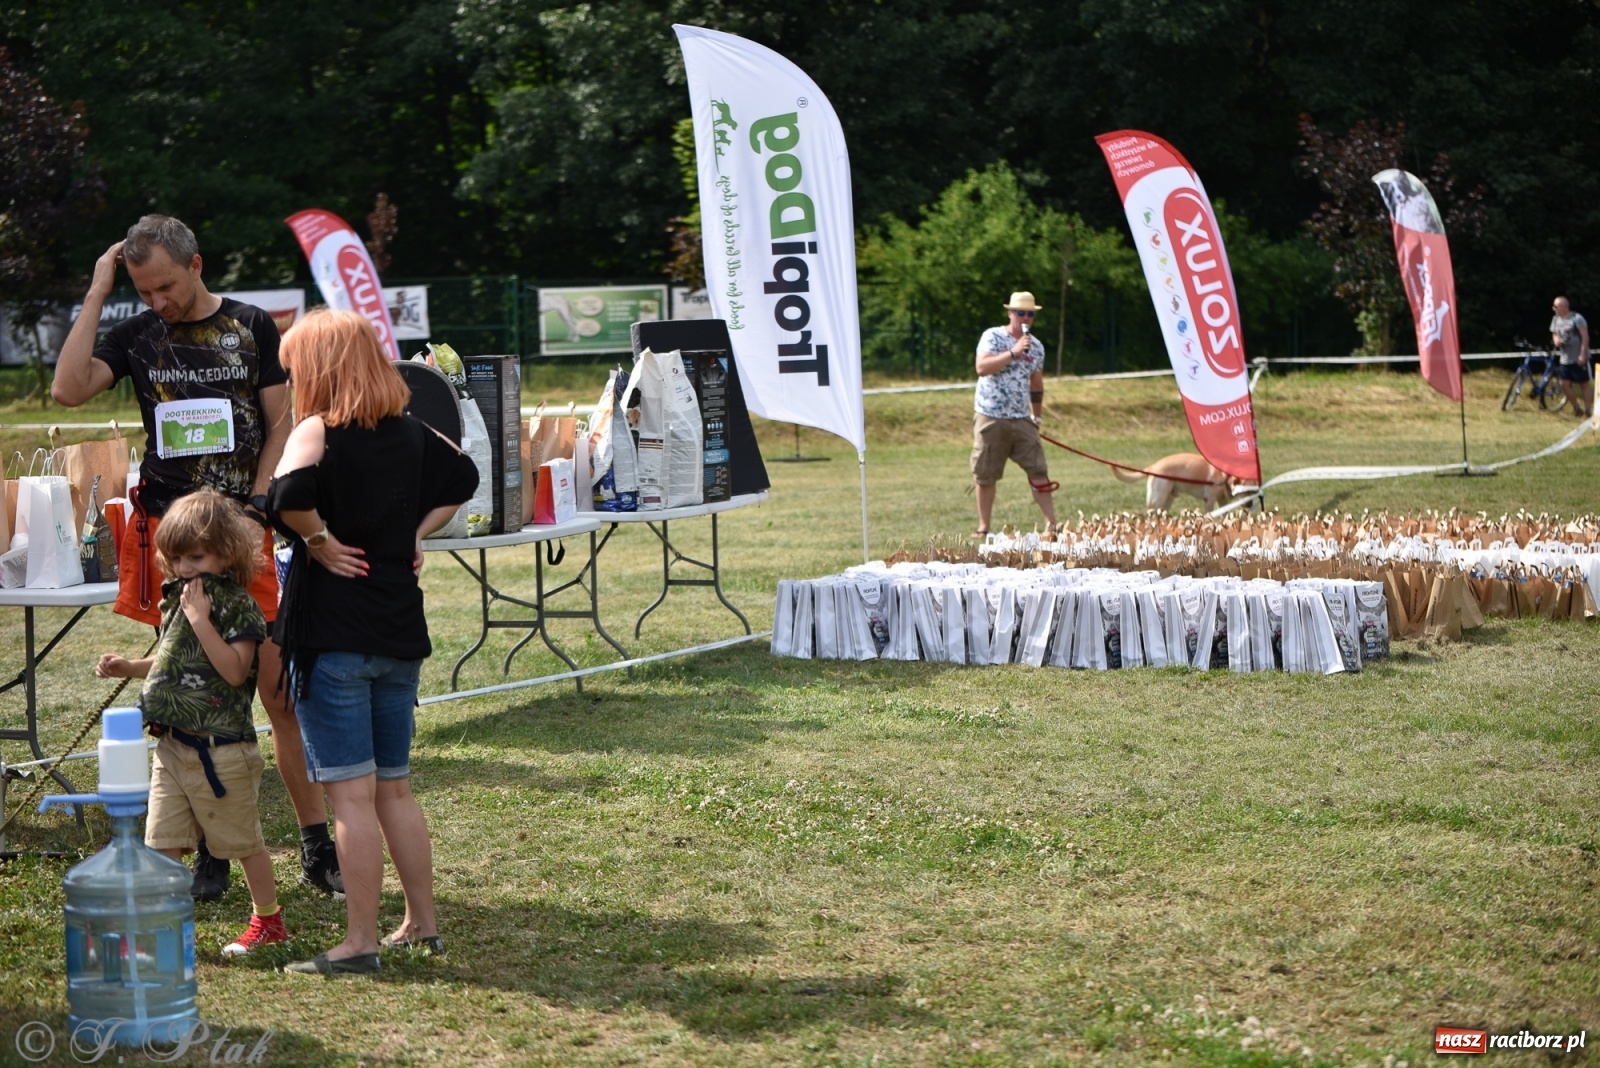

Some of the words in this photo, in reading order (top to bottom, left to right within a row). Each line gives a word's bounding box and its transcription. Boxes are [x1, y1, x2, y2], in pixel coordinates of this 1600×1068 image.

[148, 365, 249, 383] RUNMAGEDDON
[165, 408, 223, 418] DOGTREKKING
[185, 428, 205, 444] 18
